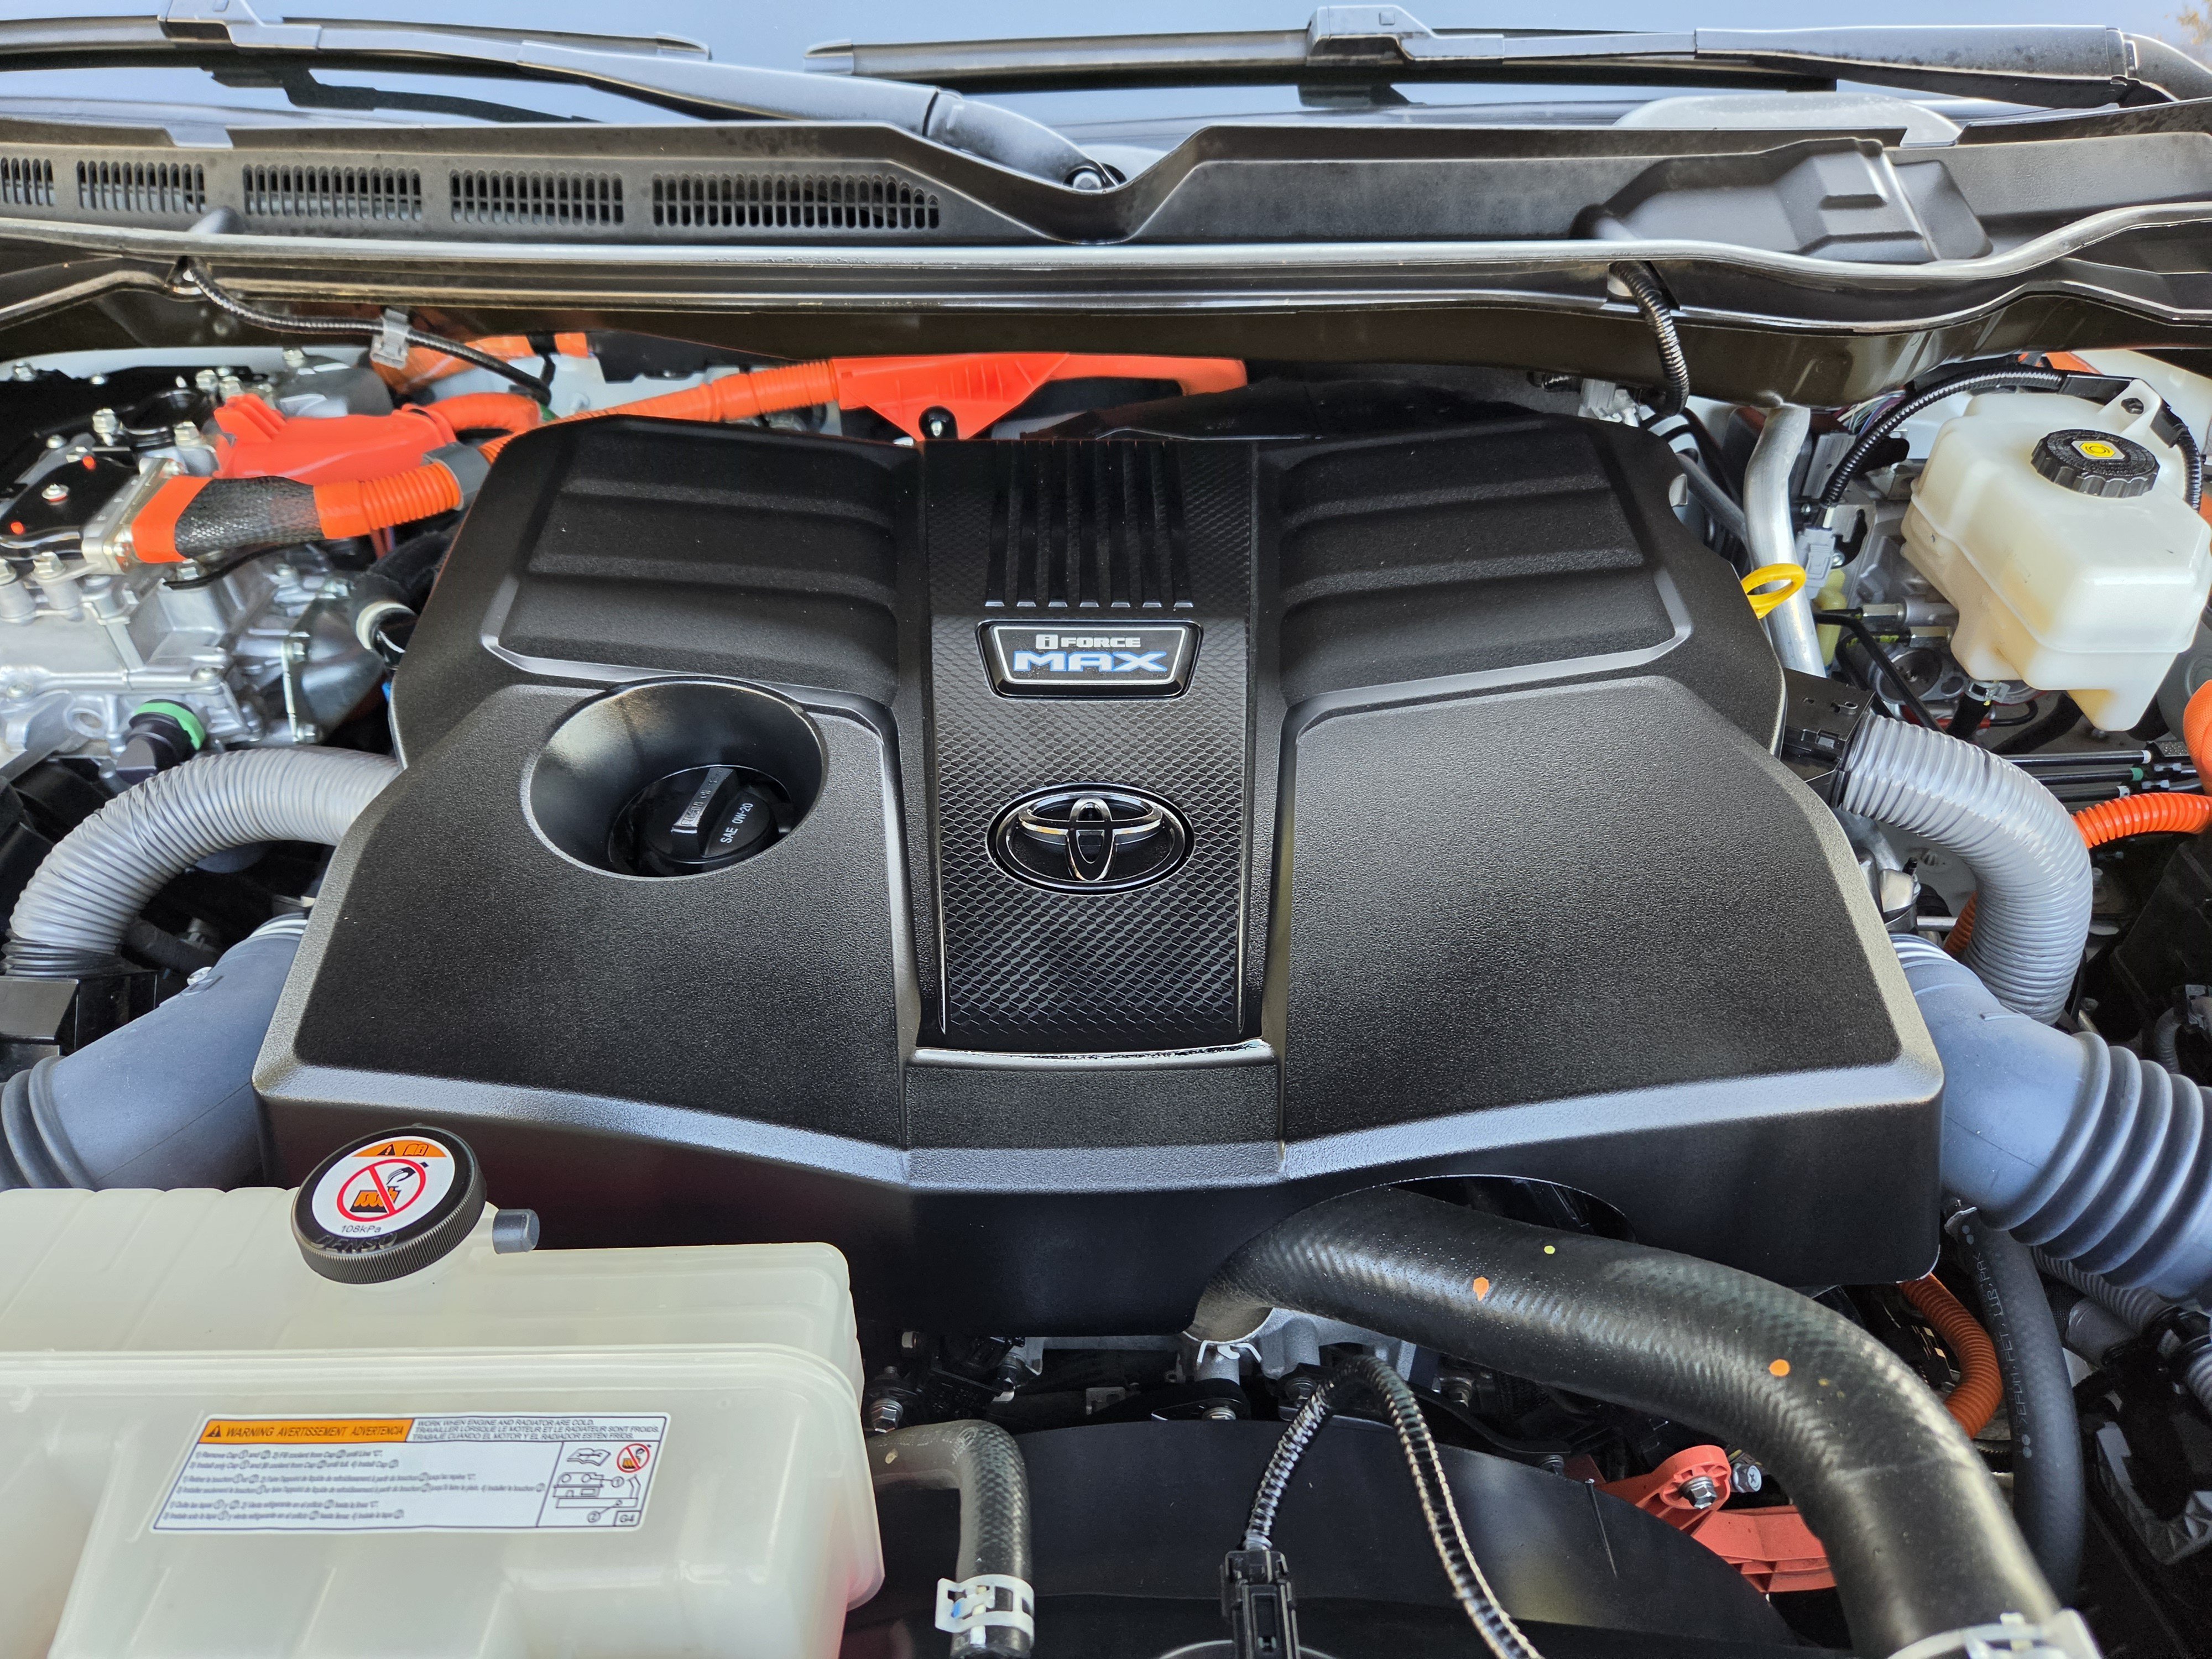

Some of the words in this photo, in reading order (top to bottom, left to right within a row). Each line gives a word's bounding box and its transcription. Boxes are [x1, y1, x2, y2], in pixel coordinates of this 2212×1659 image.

[1061, 637, 1141, 647] FORCE
[1013, 650, 1167, 672] MAX
[720, 827, 738, 843] SAE
[732, 803, 753, 824] 0W-20
[341, 1225, 382, 1233] 108kPa
[226, 1427, 275, 1437] WARNING
[276, 1427, 348, 1437] AVERTISSEMENT
[351, 1426, 404, 1436] ADVERTENCIA
[619, 1514, 635, 1523] G4
